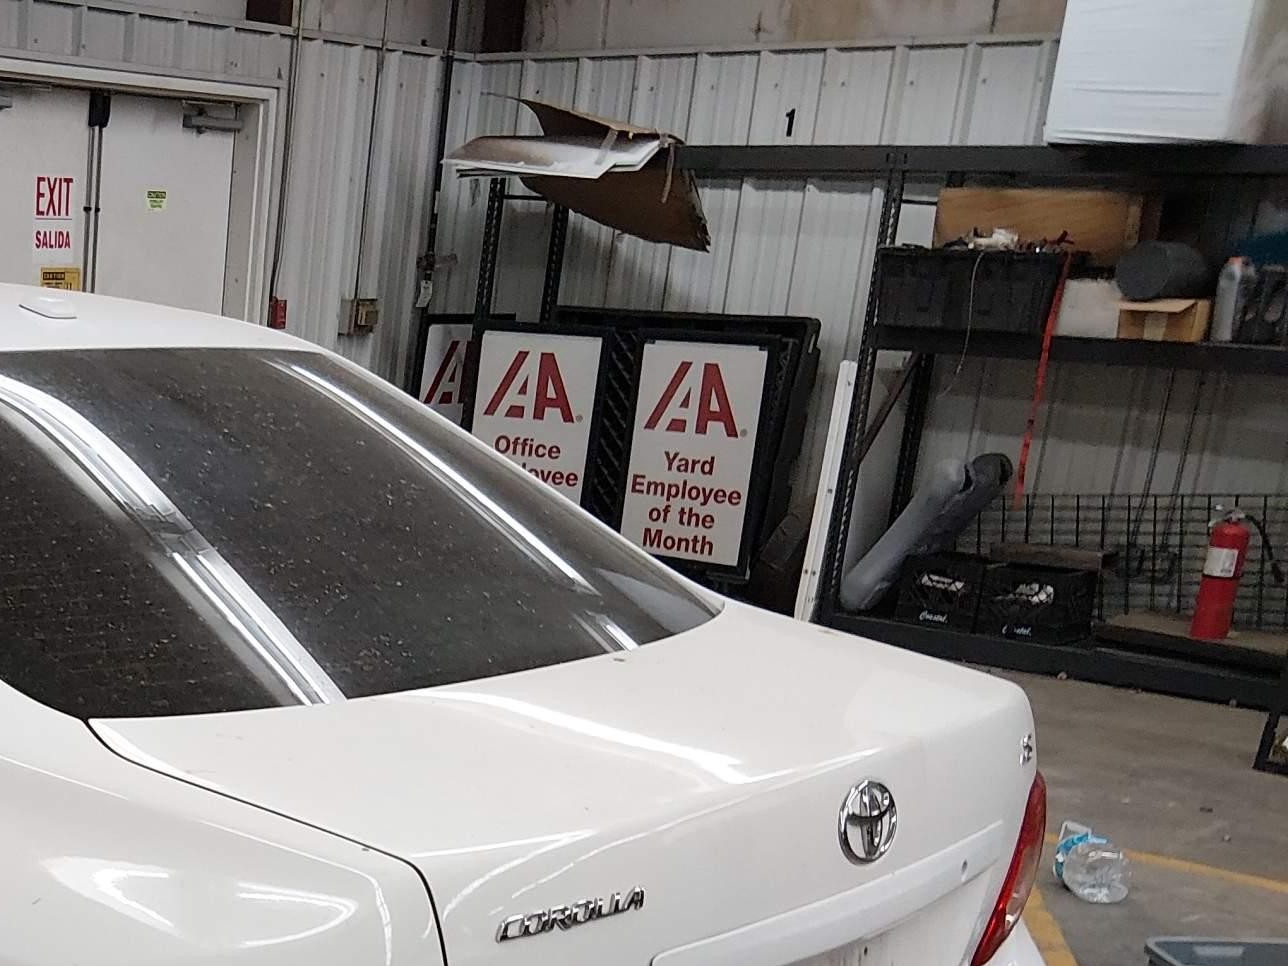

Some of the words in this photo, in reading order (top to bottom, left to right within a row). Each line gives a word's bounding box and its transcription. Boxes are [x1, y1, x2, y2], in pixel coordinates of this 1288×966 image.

[785, 108, 796, 137] 1
[36, 176, 74, 217] EXIT
[35, 230, 71, 249] SALIDA
[494, 435, 561, 460] Office
[664, 451, 716, 476] Yard
[631, 474, 742, 506] Employee
[648, 505, 671, 524] of
[678, 507, 715, 530] the
[642, 528, 714, 556] Month
[496, 886, 645, 943] COROLLA
